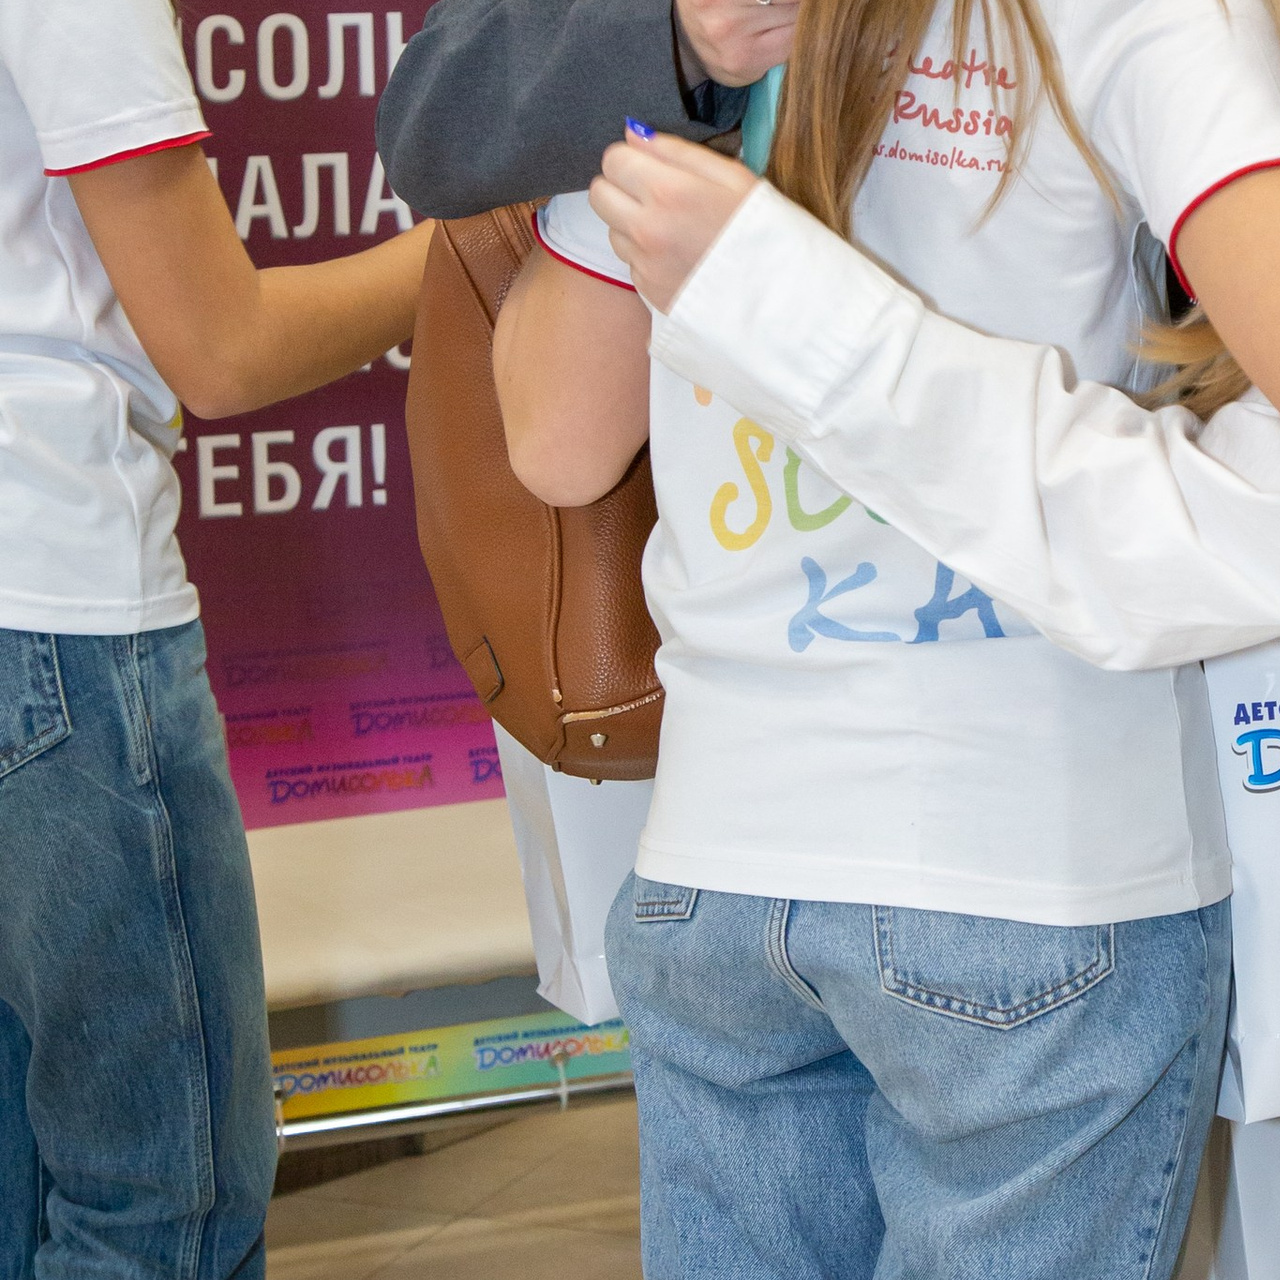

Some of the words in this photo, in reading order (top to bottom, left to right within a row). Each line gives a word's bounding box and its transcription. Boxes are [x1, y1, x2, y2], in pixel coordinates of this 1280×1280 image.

[178, 11, 408, 103] СОЛ
[889, 37, 1017, 90] eatre
[893, 90, 1013, 136] Russia
[205, 152, 414, 239] АЛА
[178, 423, 388, 519] ЕБЯ!
